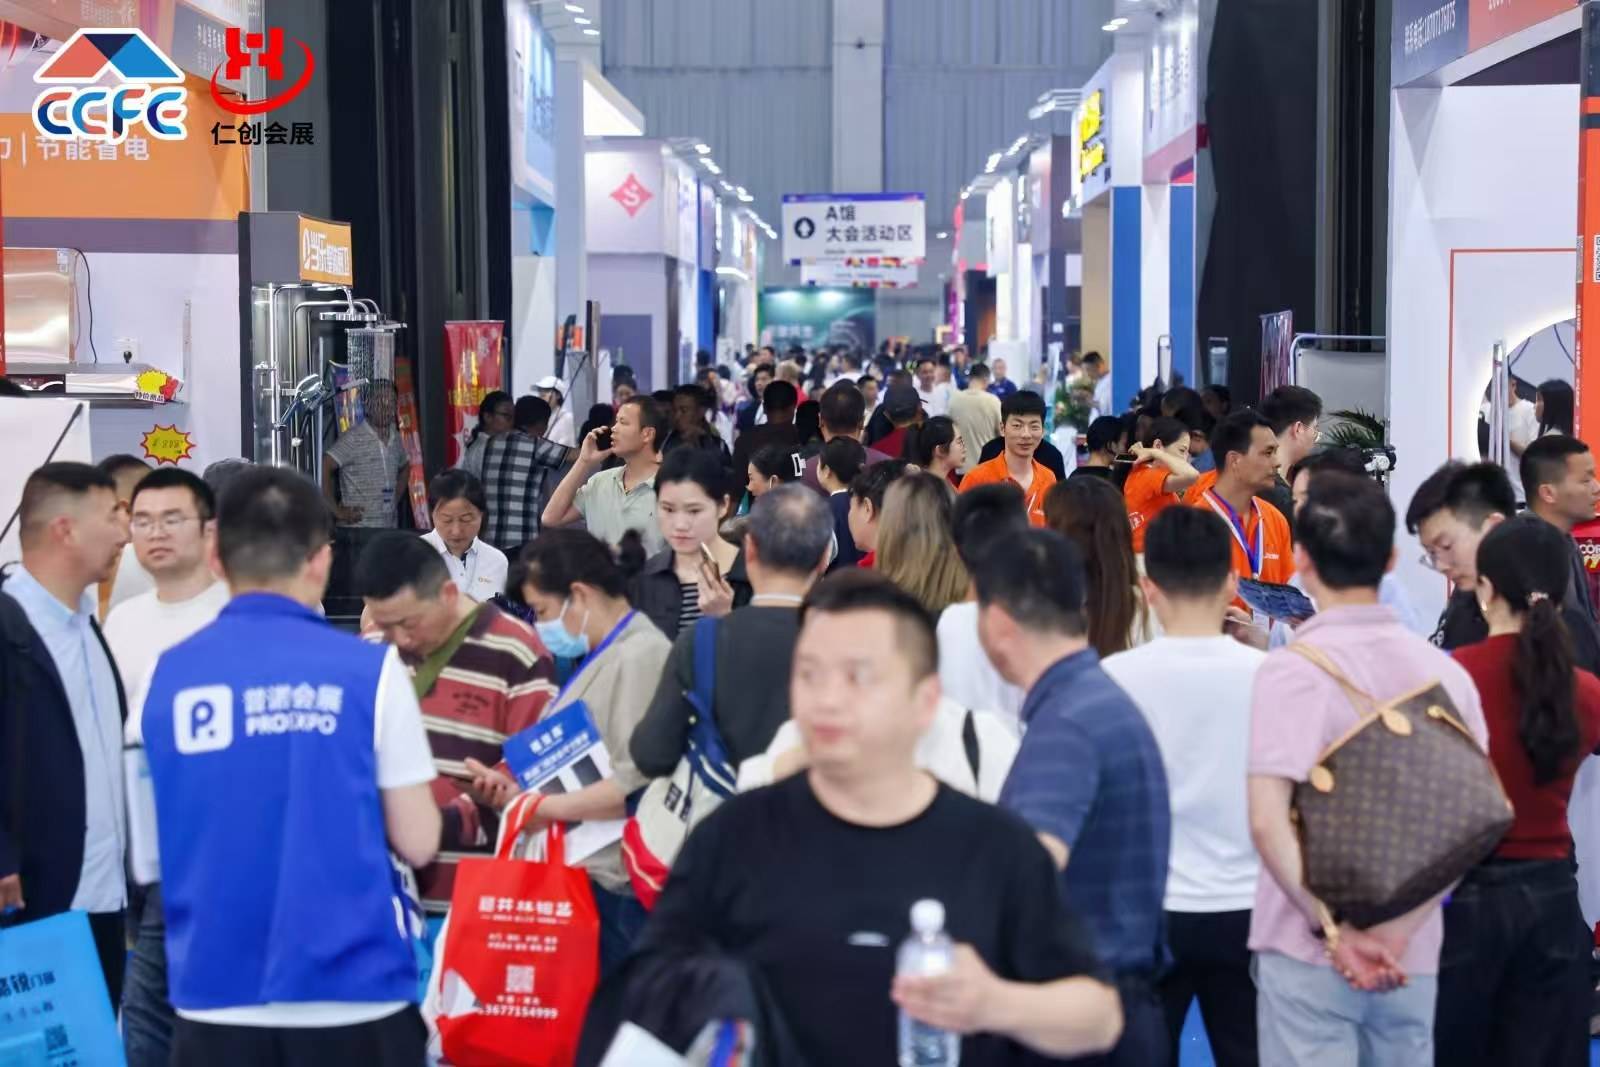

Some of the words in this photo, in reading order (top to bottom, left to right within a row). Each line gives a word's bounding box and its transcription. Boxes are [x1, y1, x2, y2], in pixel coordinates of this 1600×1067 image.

[36, 135, 149, 161] 节能省电
[826, 205, 856, 221] A馆
[826, 224, 912, 242] 大会活动区
[135, 391, 164, 402] 特价商品
